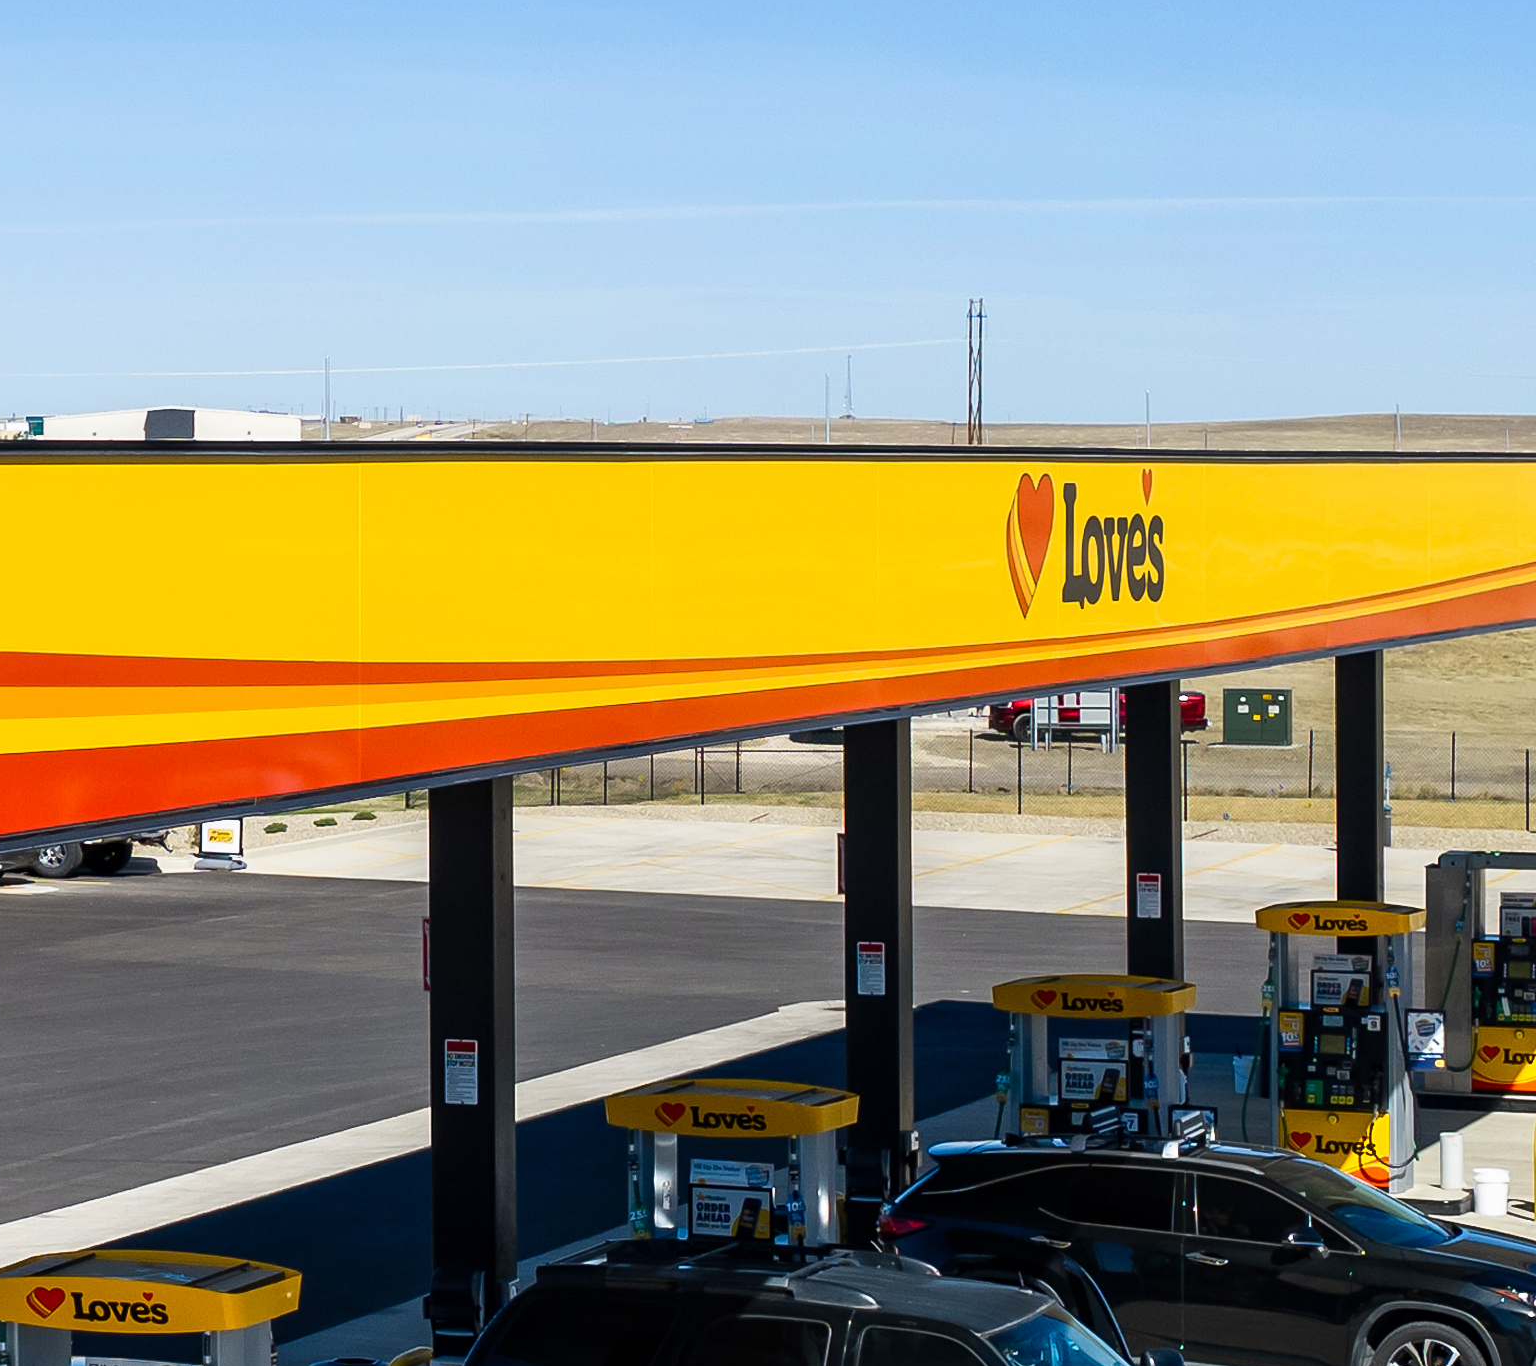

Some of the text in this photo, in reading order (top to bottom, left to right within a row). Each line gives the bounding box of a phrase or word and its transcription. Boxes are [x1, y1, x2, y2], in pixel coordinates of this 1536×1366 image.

[1062, 469, 1164, 609] Love's
[1313, 914, 1368, 931] Love's
[1061, 991, 1124, 1013] Love's
[1370, 1020, 1377, 1030] 9
[690, 1106, 767, 1131] Love's
[70, 1291, 169, 1325] Love's
